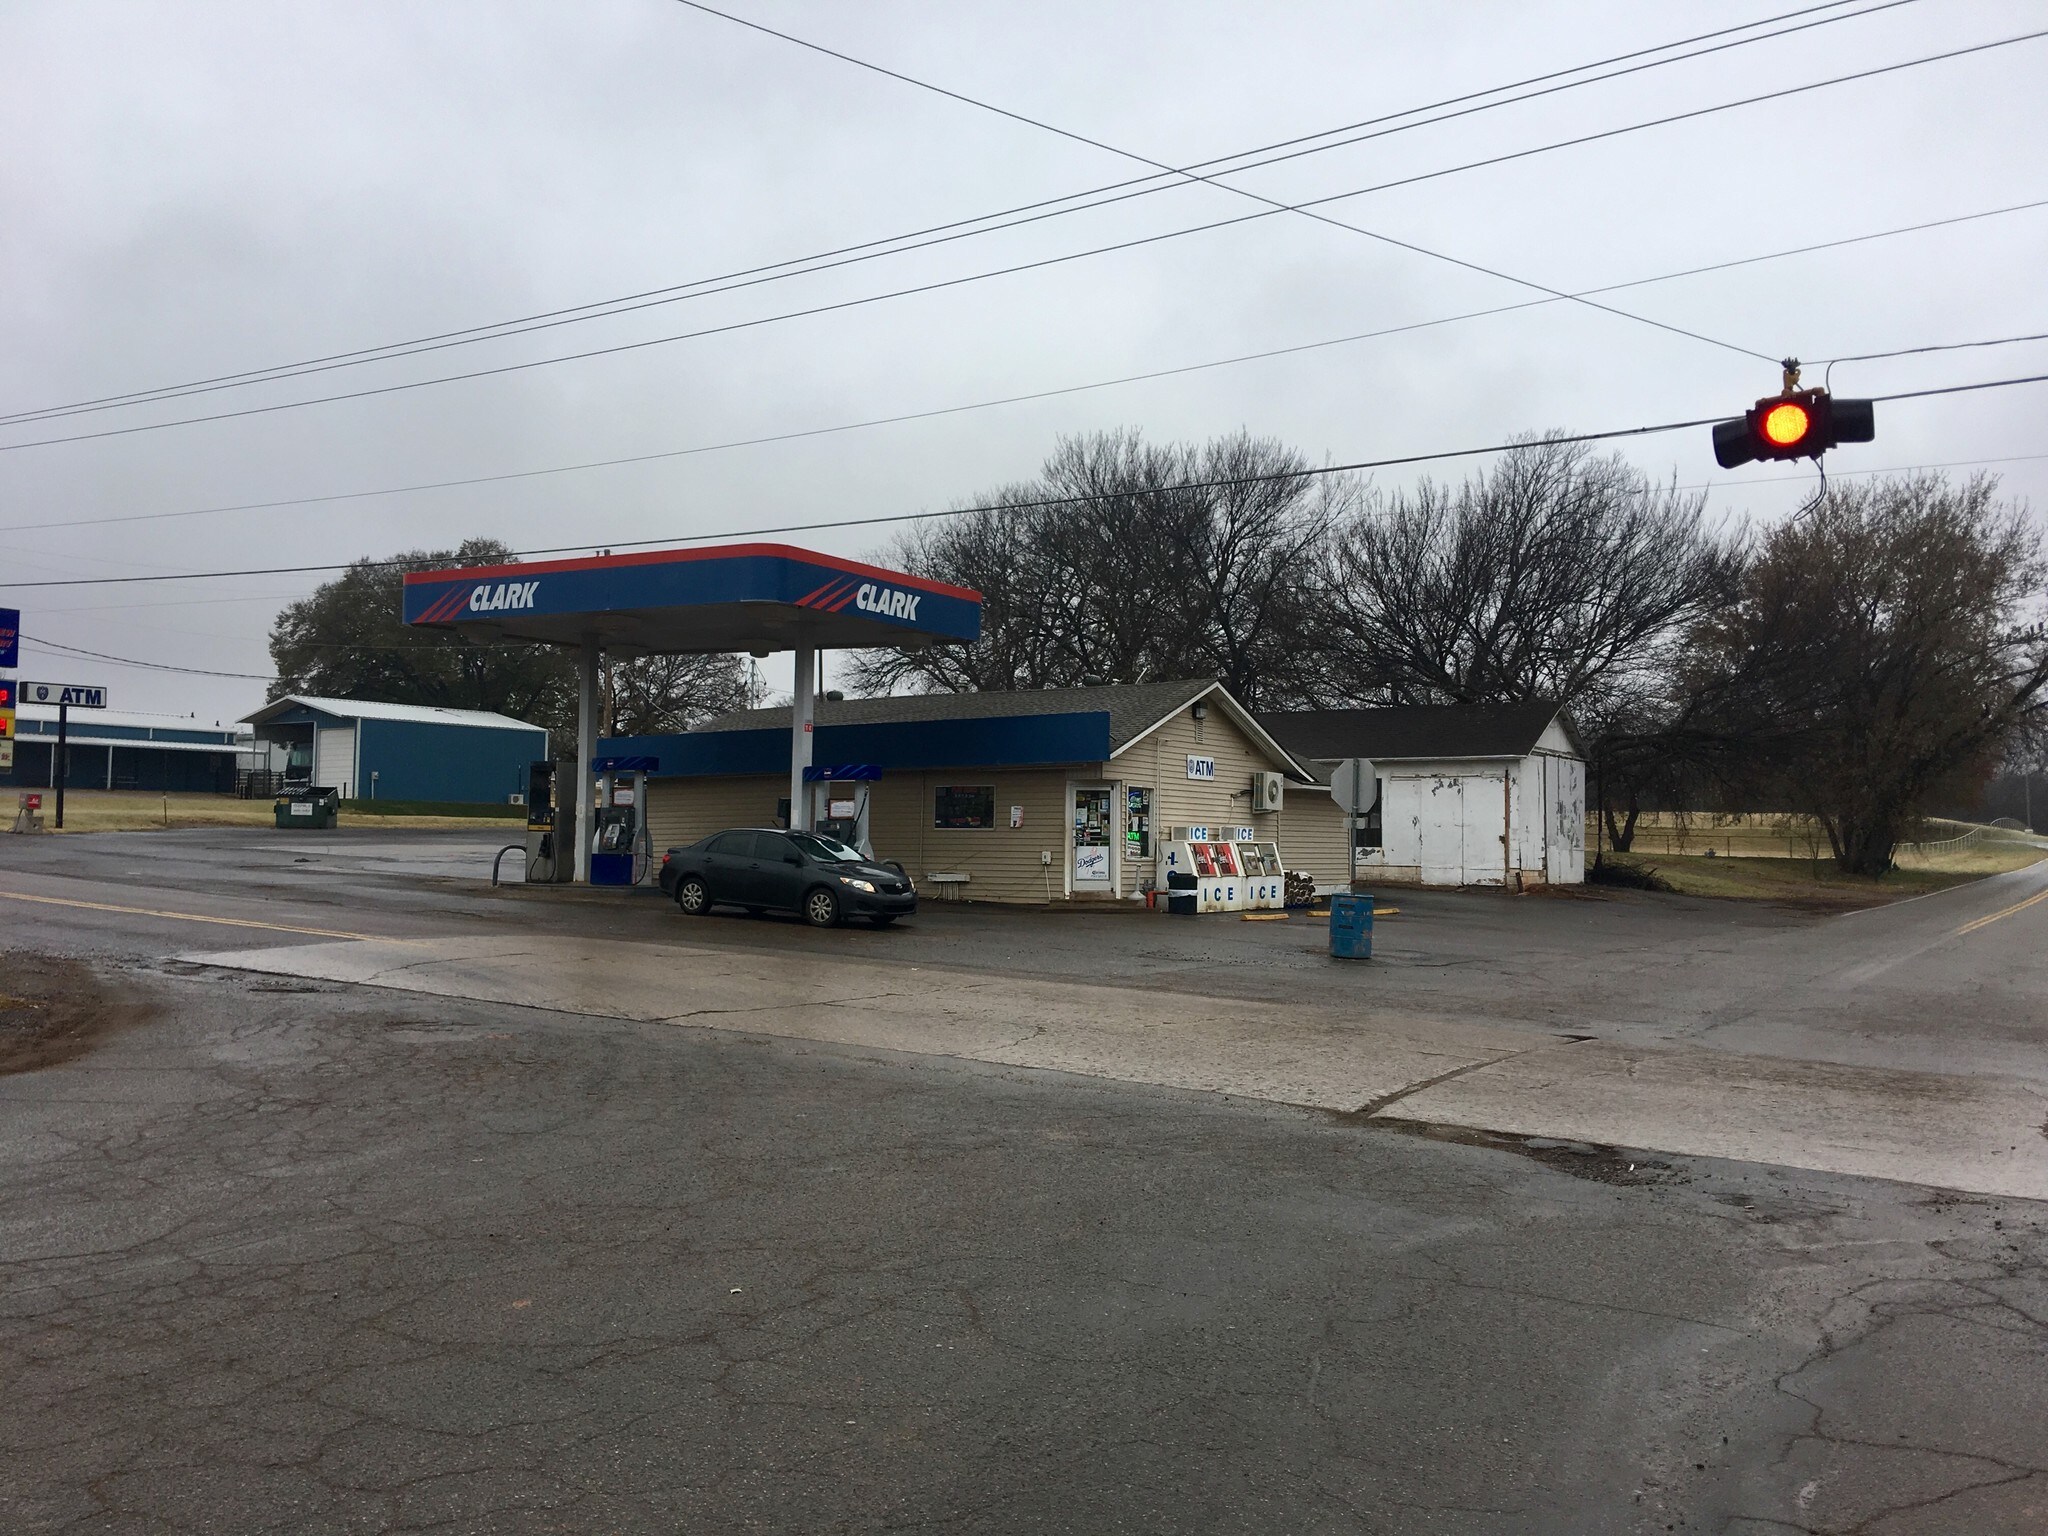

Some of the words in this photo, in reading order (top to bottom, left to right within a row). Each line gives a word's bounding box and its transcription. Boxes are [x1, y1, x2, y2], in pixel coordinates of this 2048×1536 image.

[468, 581, 540, 612] CLARK
[855, 583, 921, 622] CLARK
[59, 687, 101, 705] ATM
[1195, 760, 1213, 777] ATM
[1190, 827, 1207, 841] ICE
[1237, 828, 1253, 841] ICE
[1077, 853, 1104, 869] Dodgers
[1204, 887, 1234, 902] ICE
[1250, 885, 1276, 900] ICE
